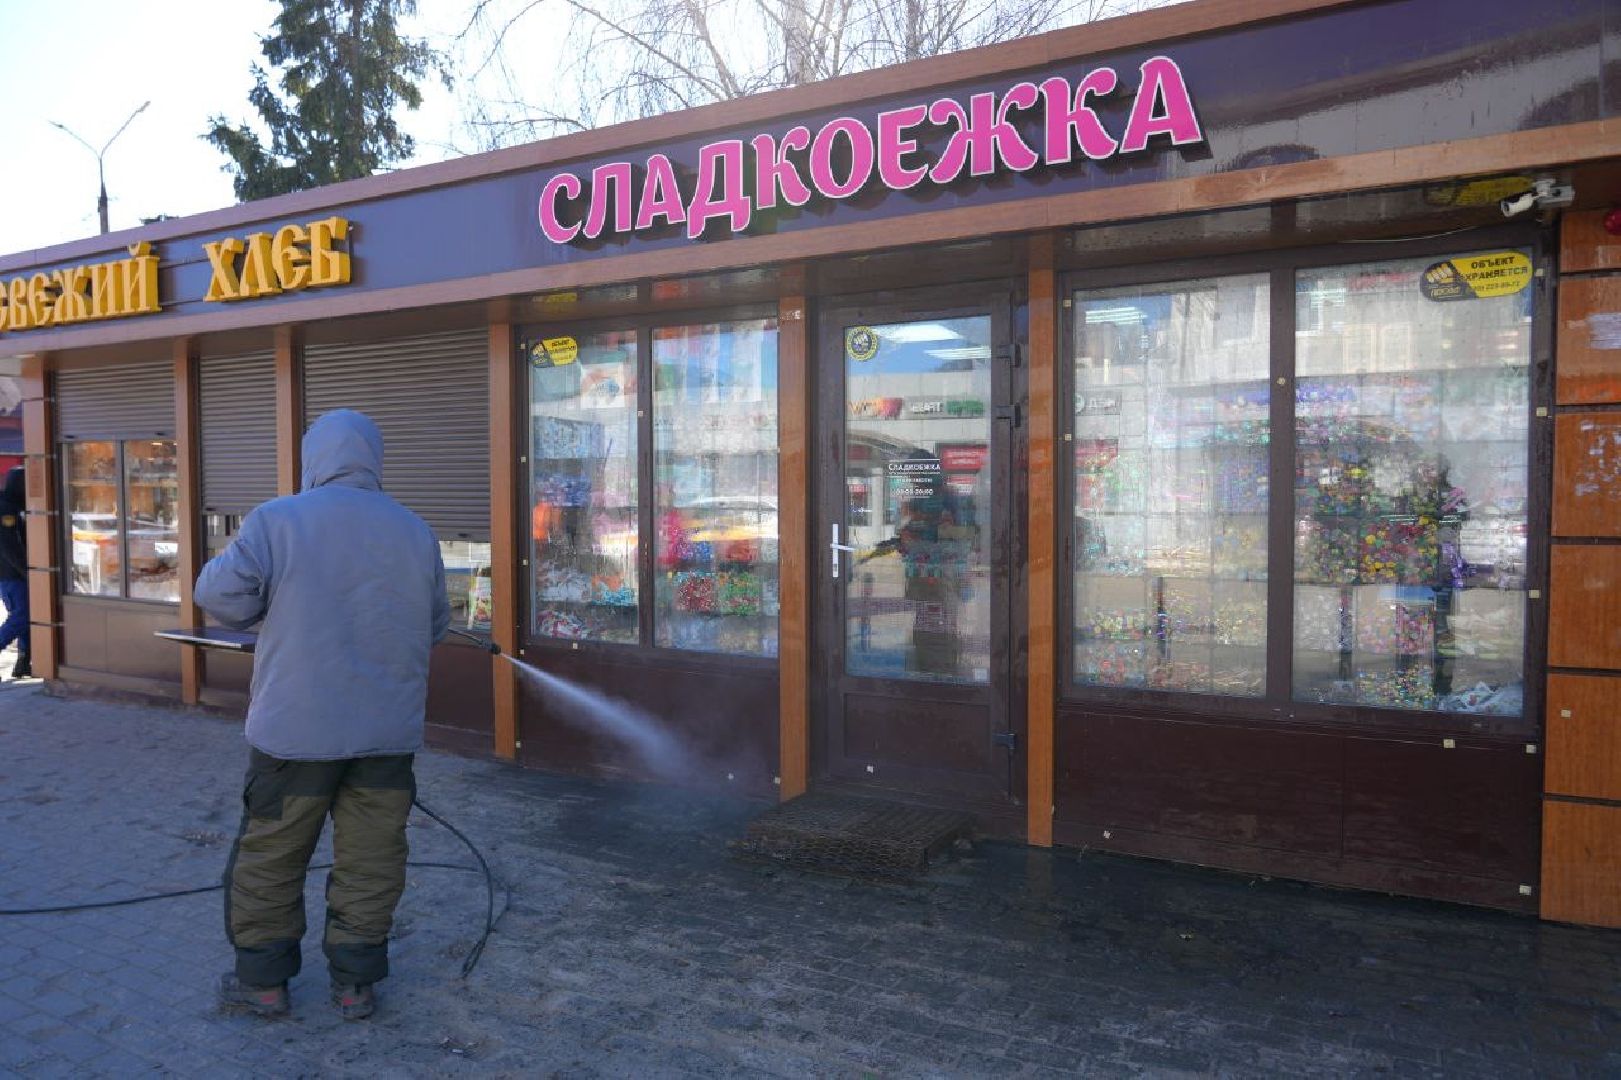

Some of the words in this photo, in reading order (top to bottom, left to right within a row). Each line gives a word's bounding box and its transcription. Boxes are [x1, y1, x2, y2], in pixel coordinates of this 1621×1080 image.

[538, 55, 1201, 244] СЛАДКОЕЖКА
[202, 216, 351, 302] ХЛЕБ
[1471, 256, 1515, 269] ОБЪЕКТ
